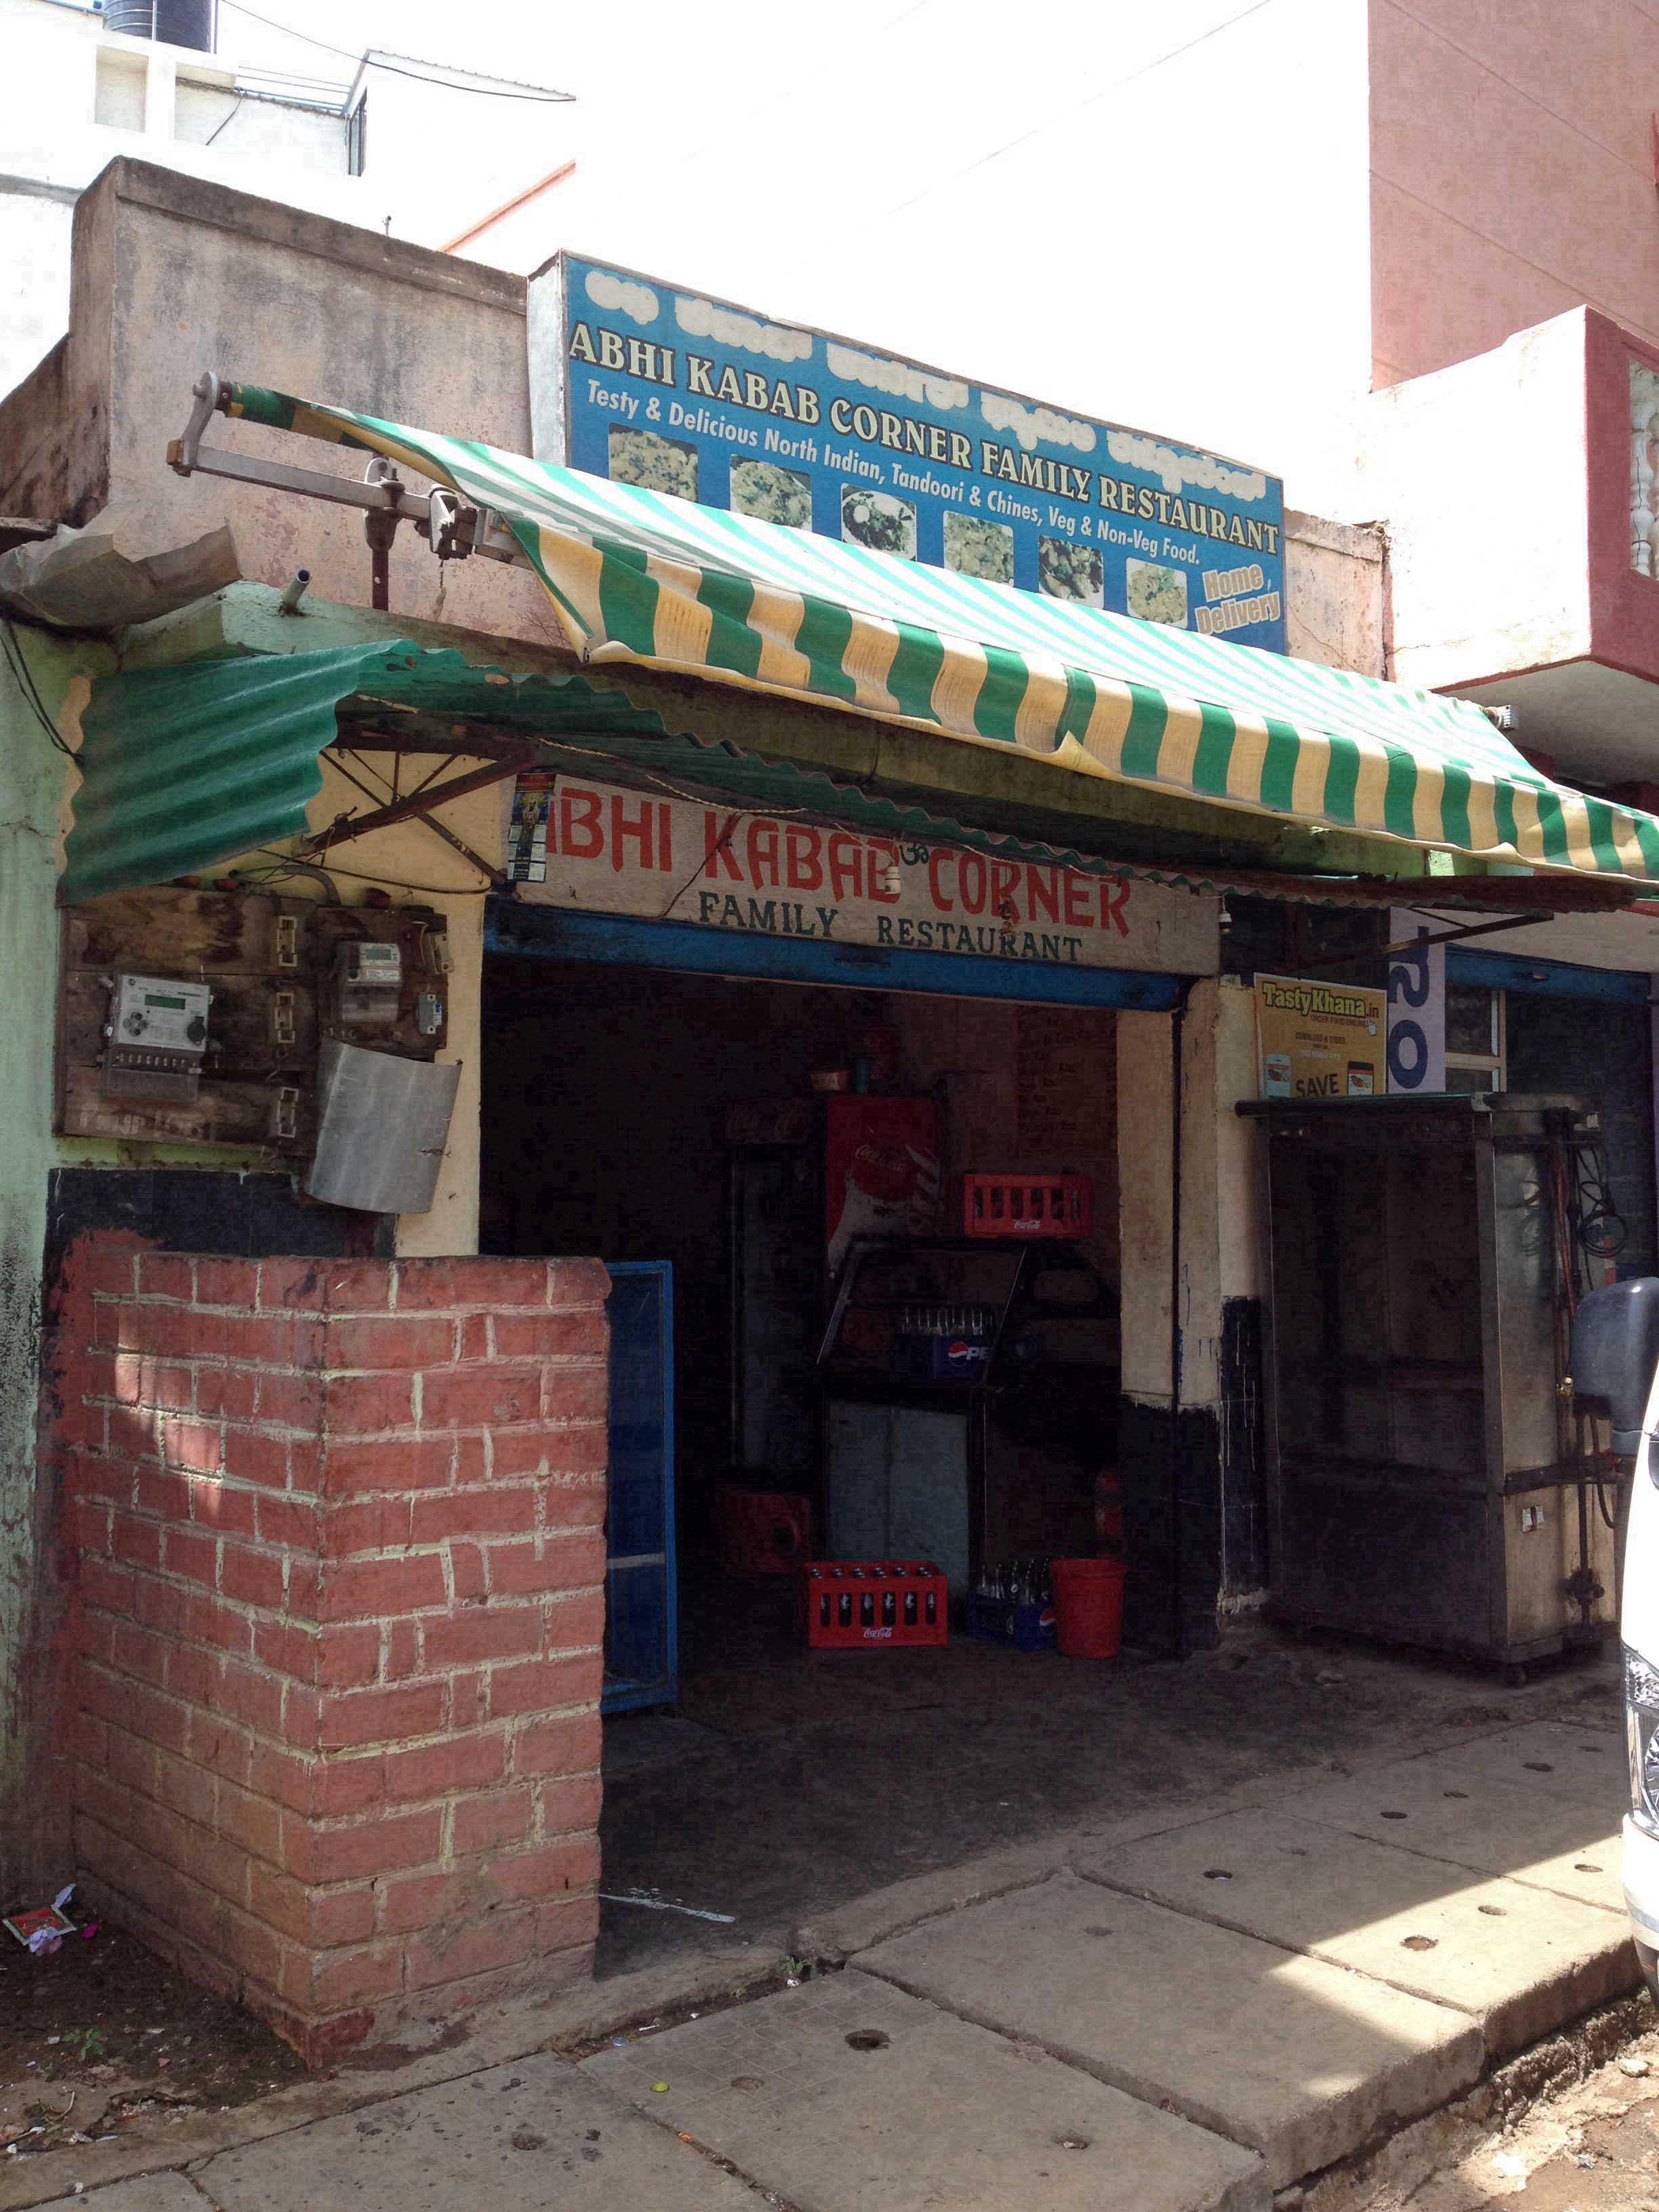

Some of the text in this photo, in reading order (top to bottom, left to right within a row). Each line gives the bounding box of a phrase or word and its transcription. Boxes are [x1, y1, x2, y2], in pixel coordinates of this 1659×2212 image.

[569, 321, 1279, 556] ABHI KABAB CORNER FAMILY RESTAURANT
[588, 379, 1200, 565] Testy & Delicious North Indian, Tandoori & Chines, Veg & Non-Veg Food.
[1202, 564, 1264, 603] Home
[1195, 591, 1281, 636] Delivery
[547, 787, 672, 873] BHI
[704, 811, 902, 903] KABAB
[928, 844, 1131, 939] CORNER
[699, 891, 1084, 962] FAMILY RESTAURANT
[1262, 982, 1379, 1019] TastyKhana.in
[1295, 1073, 1340, 1097] SAVE
